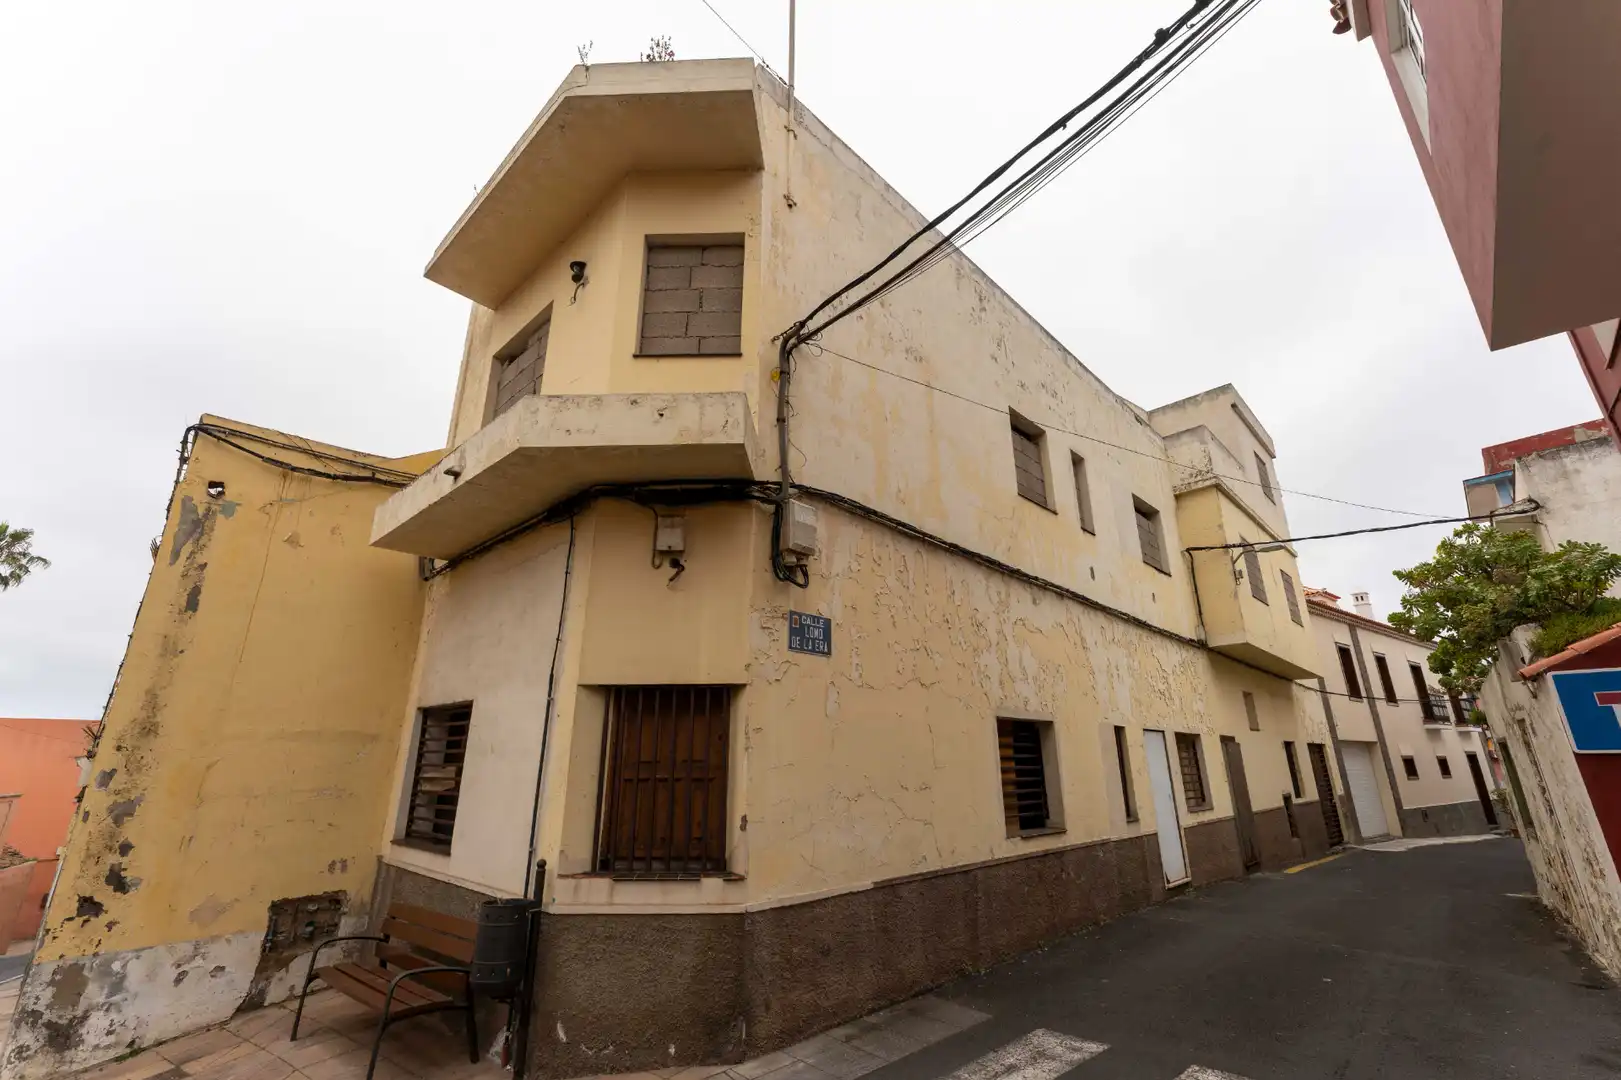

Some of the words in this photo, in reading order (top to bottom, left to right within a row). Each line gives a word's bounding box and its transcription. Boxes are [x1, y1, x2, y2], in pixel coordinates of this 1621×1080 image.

[801, 615, 825, 628] CALLE
[804, 625, 824, 640] LOMO
[791, 636, 801, 649] DE
[803, 638, 812, 650] LA
[815, 640, 828, 653] ERA
